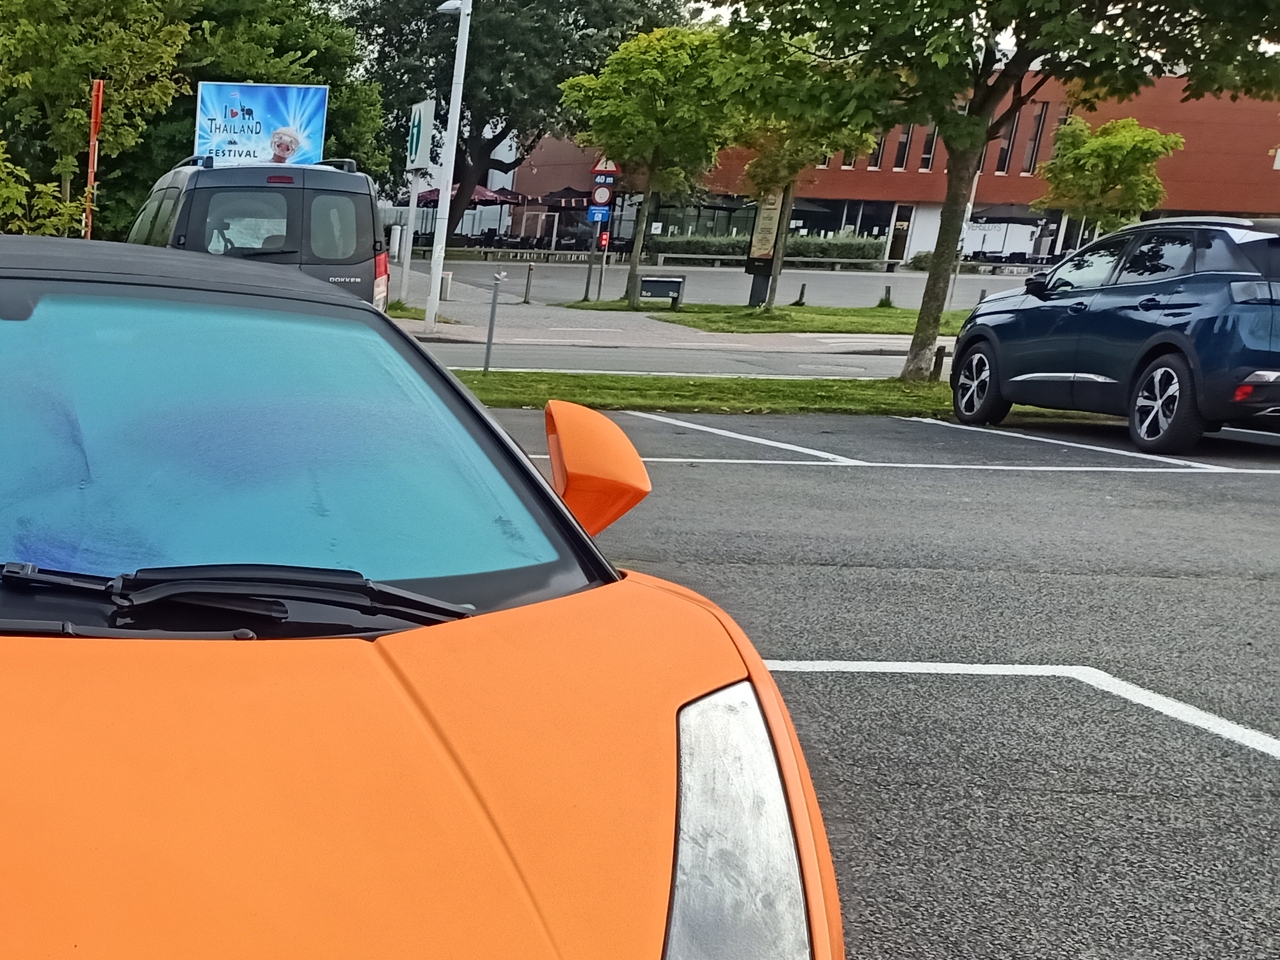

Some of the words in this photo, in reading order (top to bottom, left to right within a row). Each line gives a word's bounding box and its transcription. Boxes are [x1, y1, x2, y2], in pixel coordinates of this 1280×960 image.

[223, 104, 228, 119] I
[207, 117, 262, 135] THAILAND
[208, 148, 258, 159] FESTIVAL
[595, 175, 606, 183] 40
